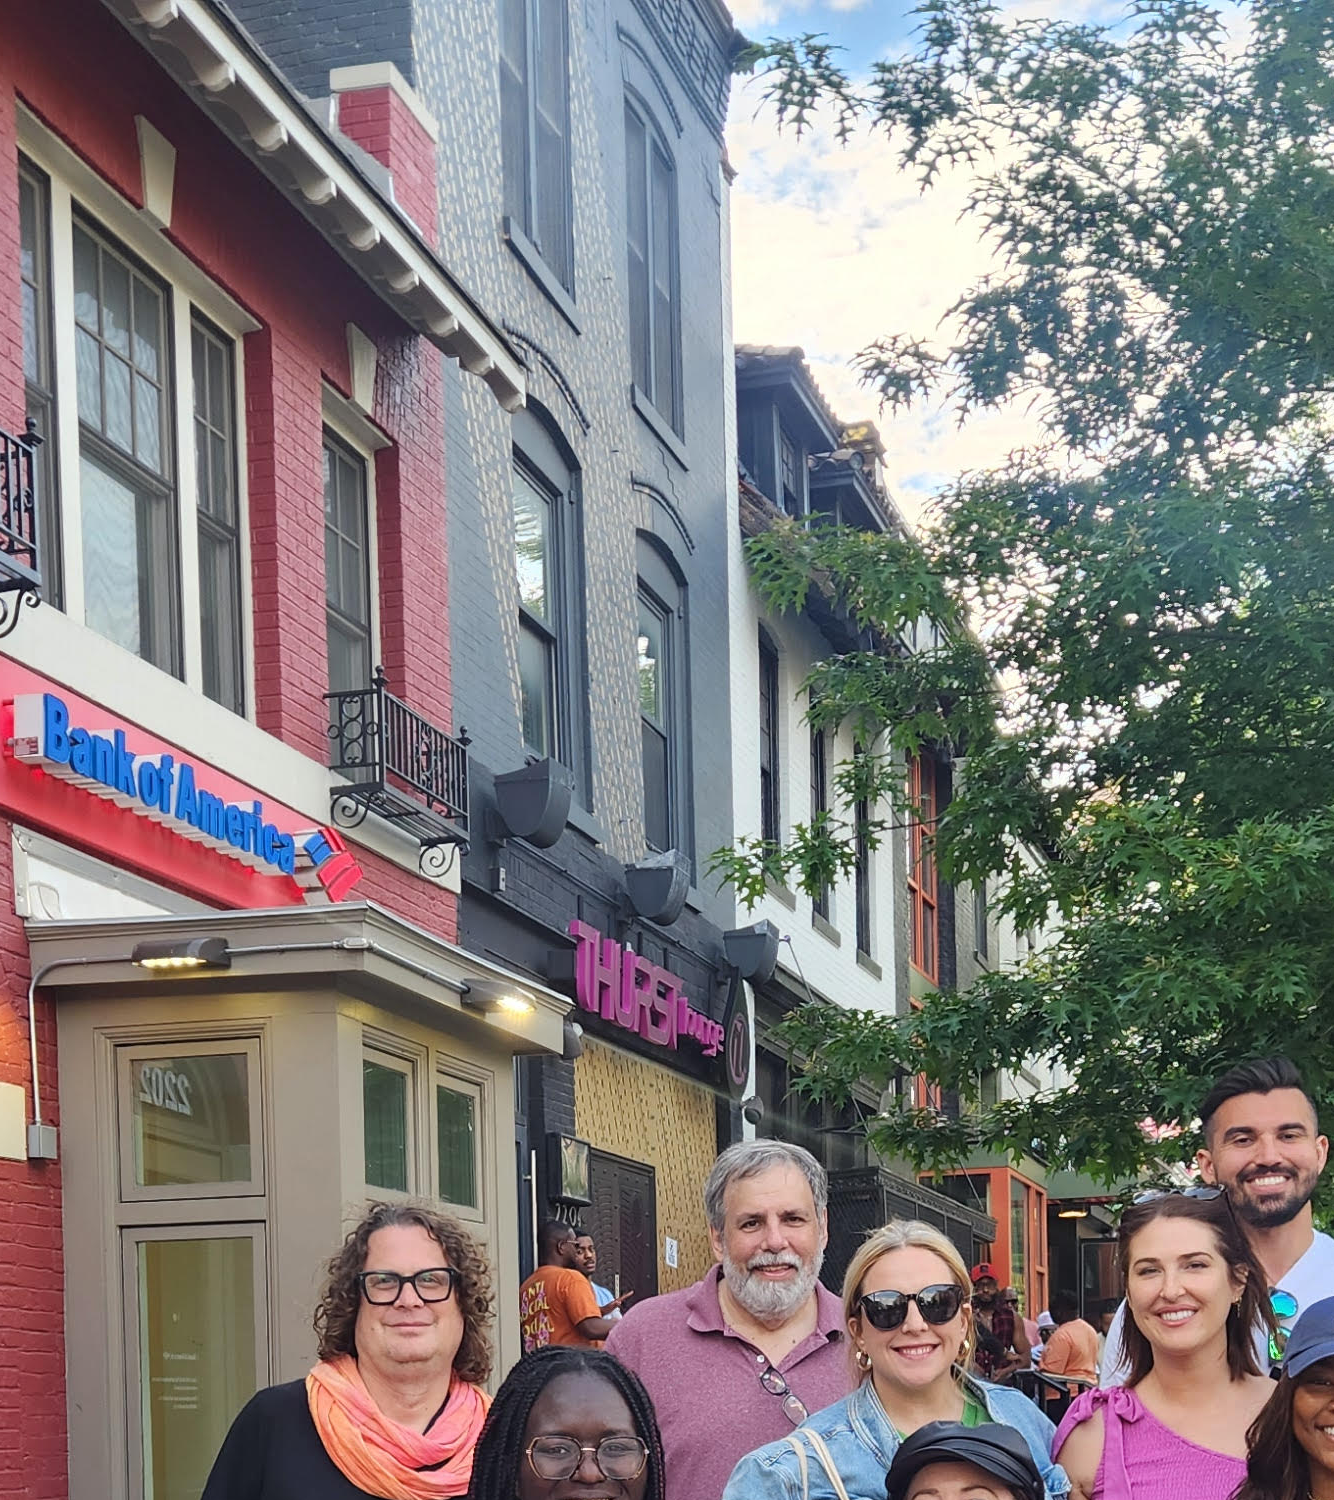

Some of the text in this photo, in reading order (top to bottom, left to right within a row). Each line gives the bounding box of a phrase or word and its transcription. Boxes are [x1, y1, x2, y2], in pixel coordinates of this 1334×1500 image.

[43, 692, 296, 875] Bank of America
[569, 919, 684, 1050] THURST
